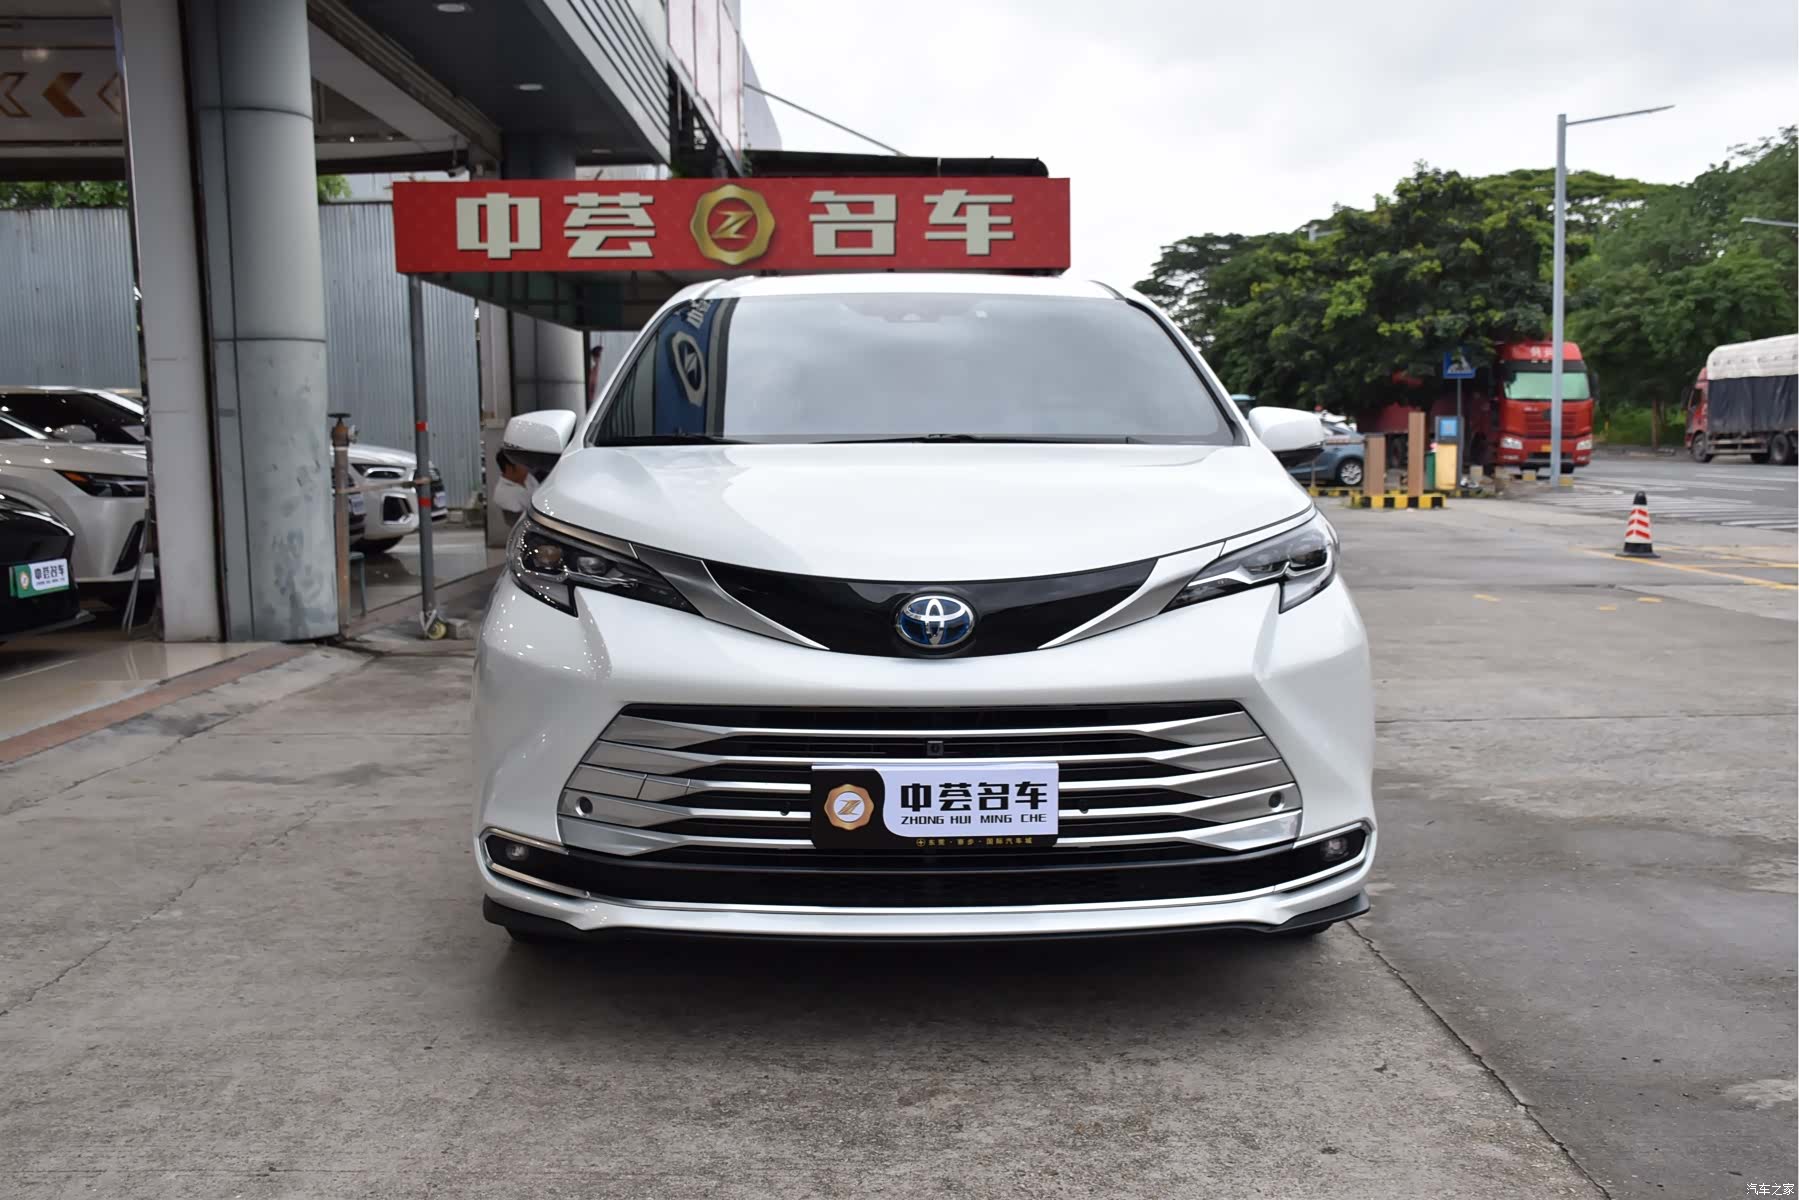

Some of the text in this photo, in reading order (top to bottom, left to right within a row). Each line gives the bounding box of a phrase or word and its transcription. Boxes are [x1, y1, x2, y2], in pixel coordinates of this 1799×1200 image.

[456, 192, 656, 258] 中荟
[809, 189, 1015, 256] 名车
[901, 781, 1048, 812] 中荟名车
[901, 813, 1048, 825] ZHONG HUI MING CHE
